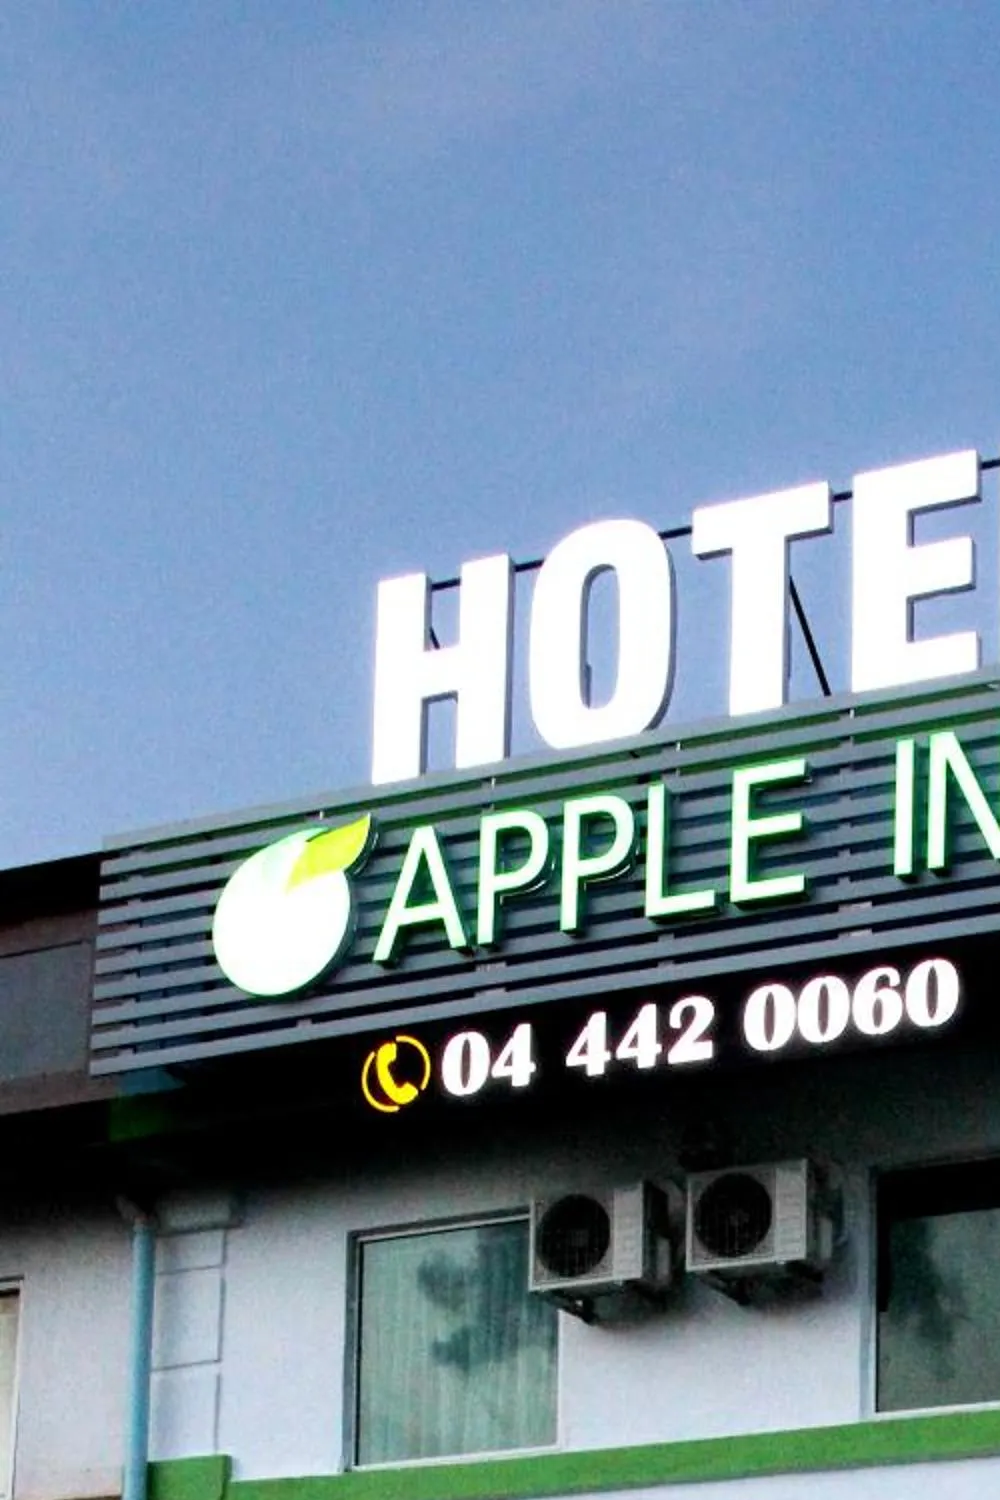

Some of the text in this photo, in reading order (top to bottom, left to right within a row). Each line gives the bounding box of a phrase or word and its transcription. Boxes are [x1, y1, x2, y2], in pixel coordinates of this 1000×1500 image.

[373, 757, 808, 964] APPLE
[440, 957, 961, 1097] 04 442 0060
